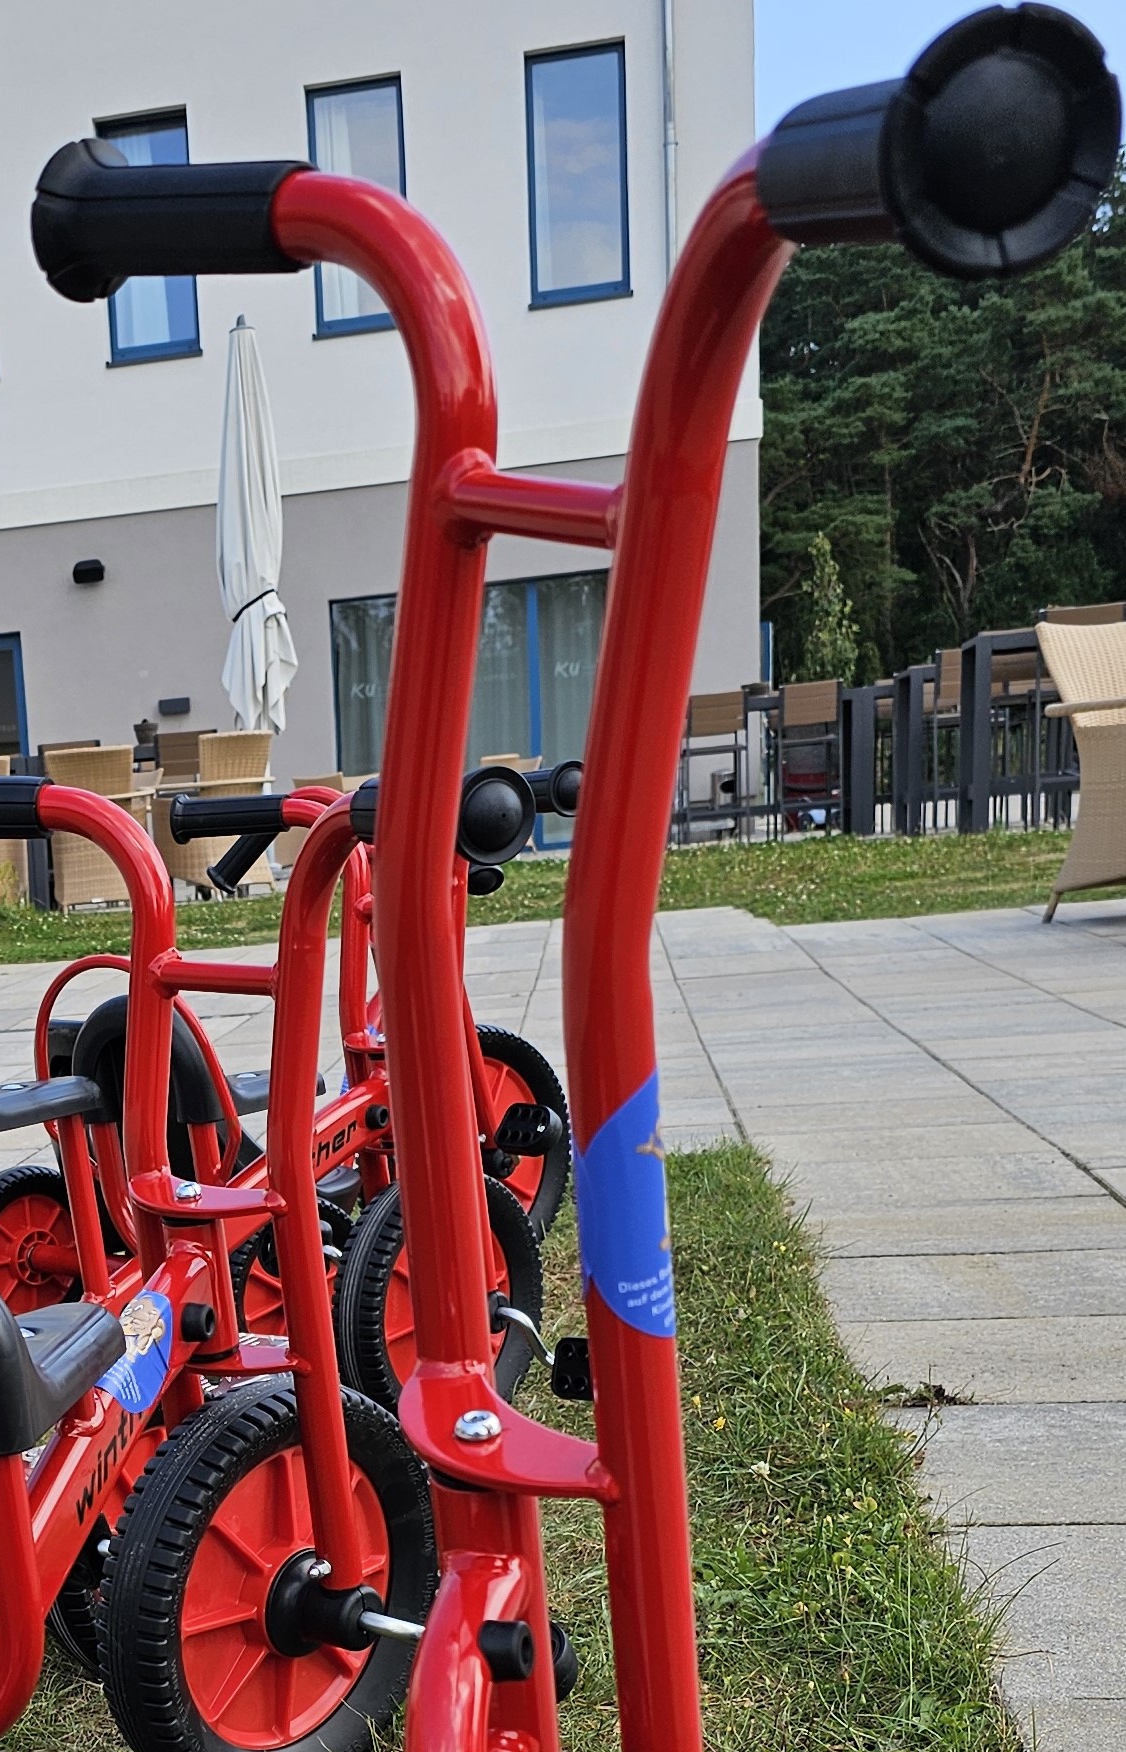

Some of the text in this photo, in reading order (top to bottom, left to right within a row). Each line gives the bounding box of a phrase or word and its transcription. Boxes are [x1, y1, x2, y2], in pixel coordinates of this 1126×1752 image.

[554, 661, 581, 679] KU
[350, 682, 377, 699] KU
[312, 1119, 357, 1169] her
[417, 1491, 436, 1553] WINTHER
